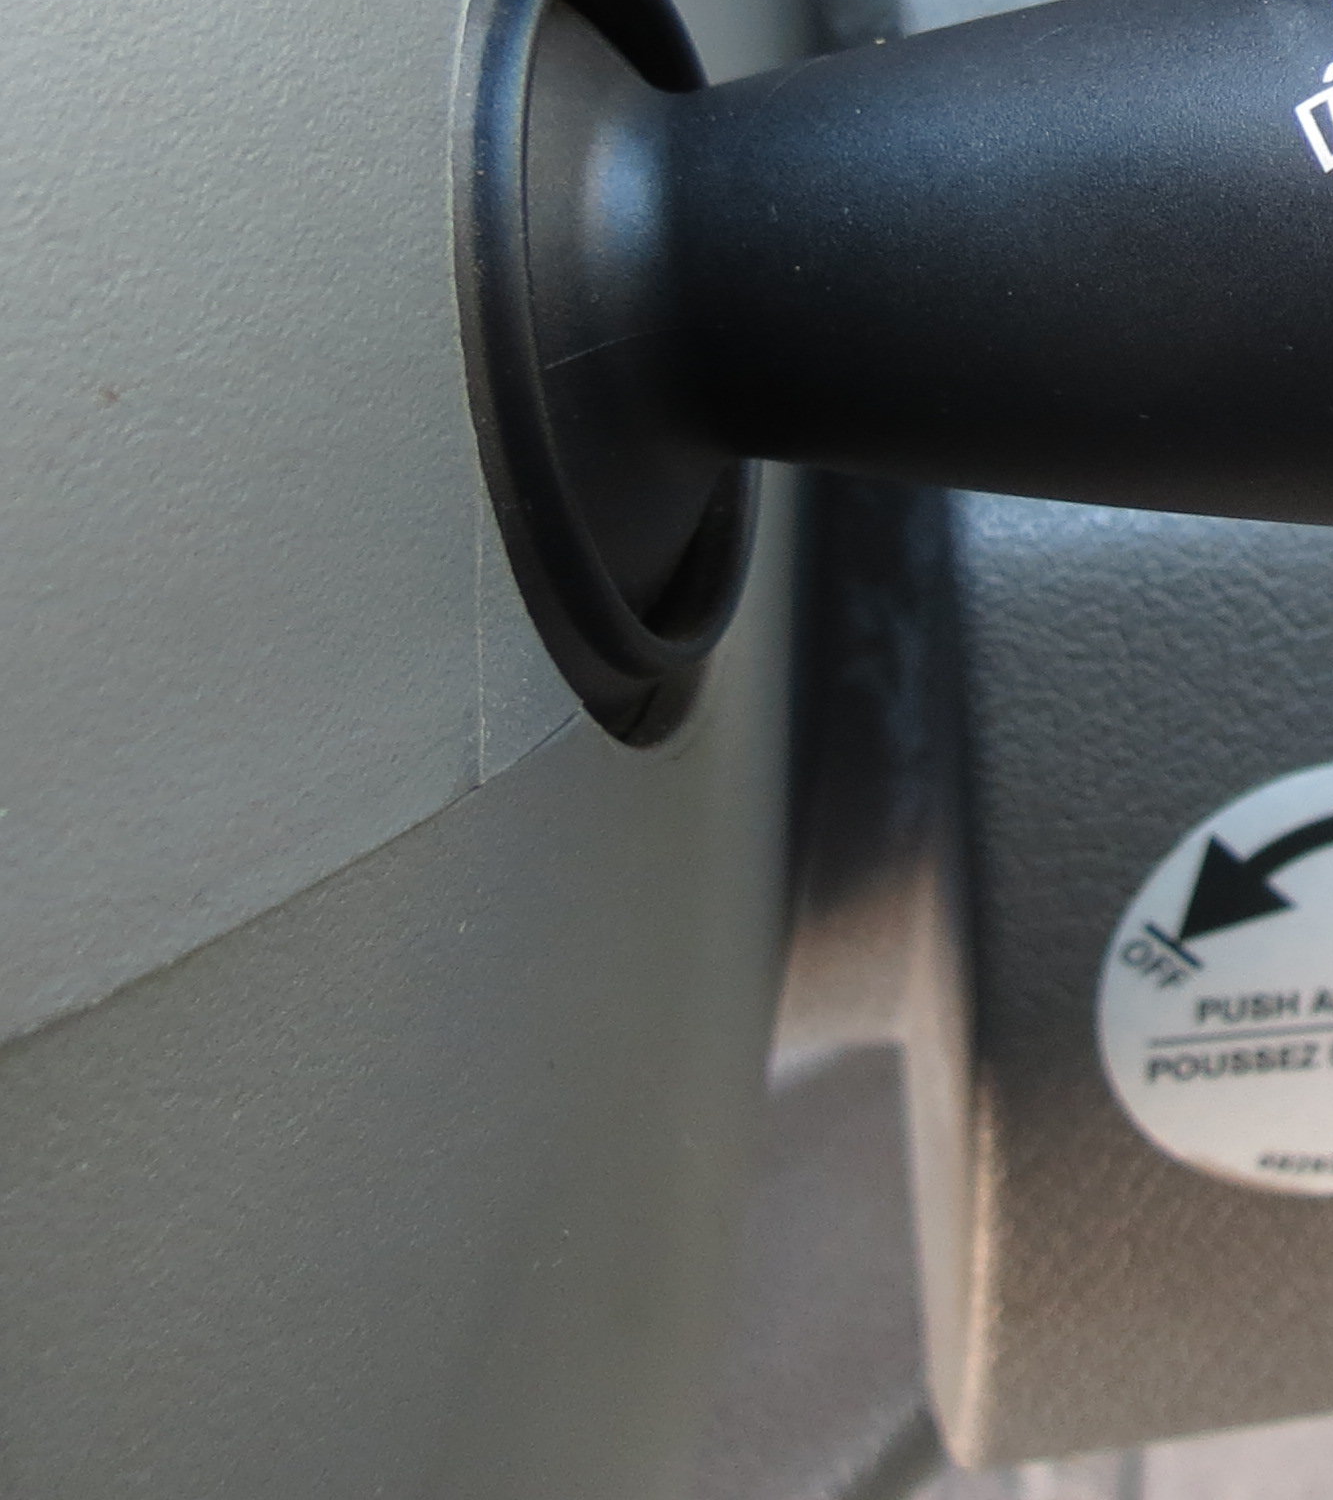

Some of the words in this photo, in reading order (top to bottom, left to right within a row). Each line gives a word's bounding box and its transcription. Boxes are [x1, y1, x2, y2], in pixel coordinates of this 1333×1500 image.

[1119, 938, 1194, 992] OFF
[1195, 984, 1299, 1024] PUSH
[1145, 1040, 1321, 1084] POUSSEZ
